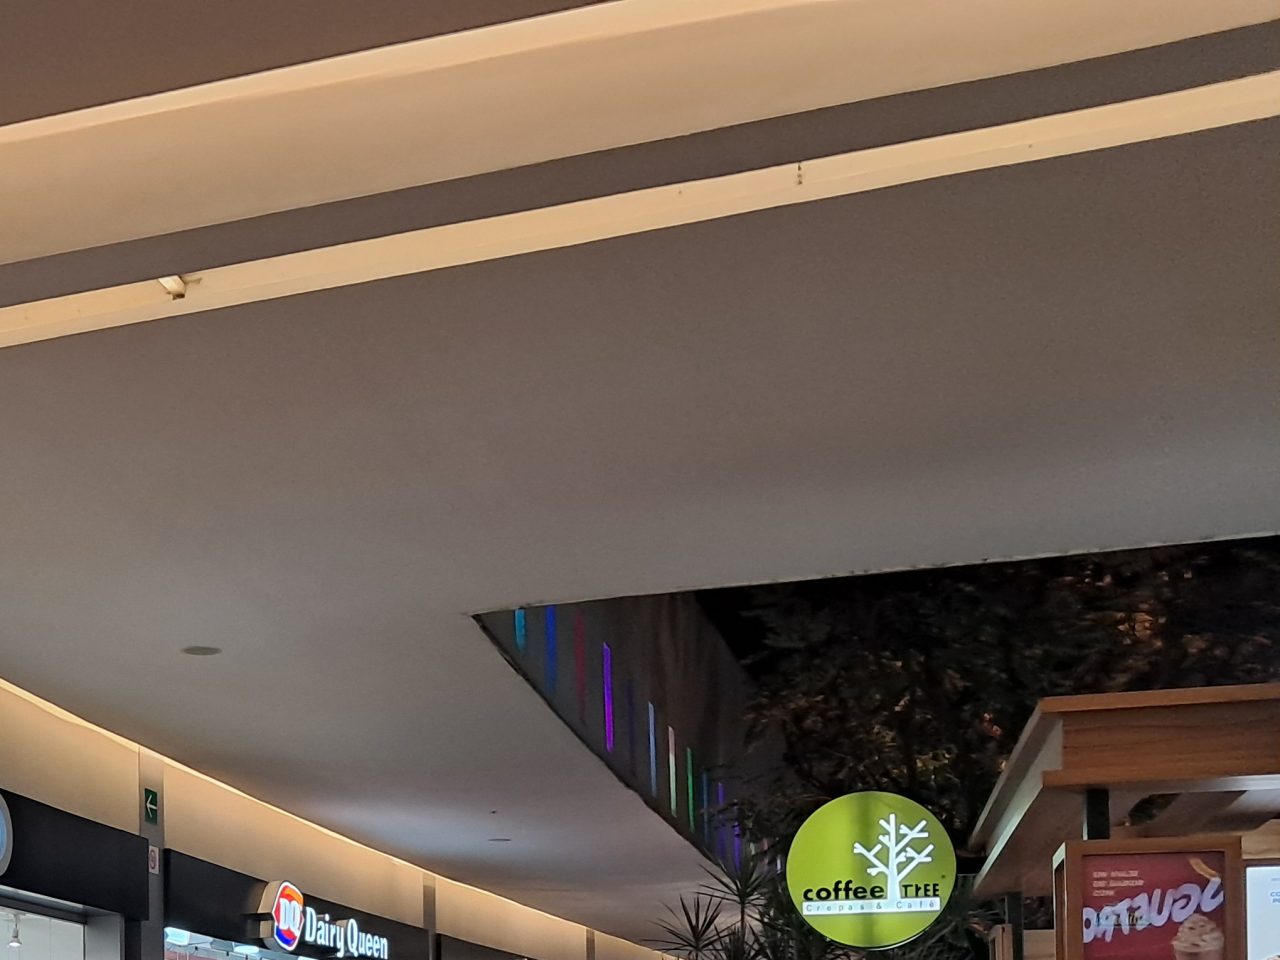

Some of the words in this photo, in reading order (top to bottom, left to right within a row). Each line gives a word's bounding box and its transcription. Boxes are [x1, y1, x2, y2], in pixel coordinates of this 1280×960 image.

[803, 880, 884, 901] coffee
[806, 904, 865, 913] Crepas
[279, 897, 301, 937] DQ
[304, 906, 345, 958] Dairy
[347, 918, 389, 960] Queen
